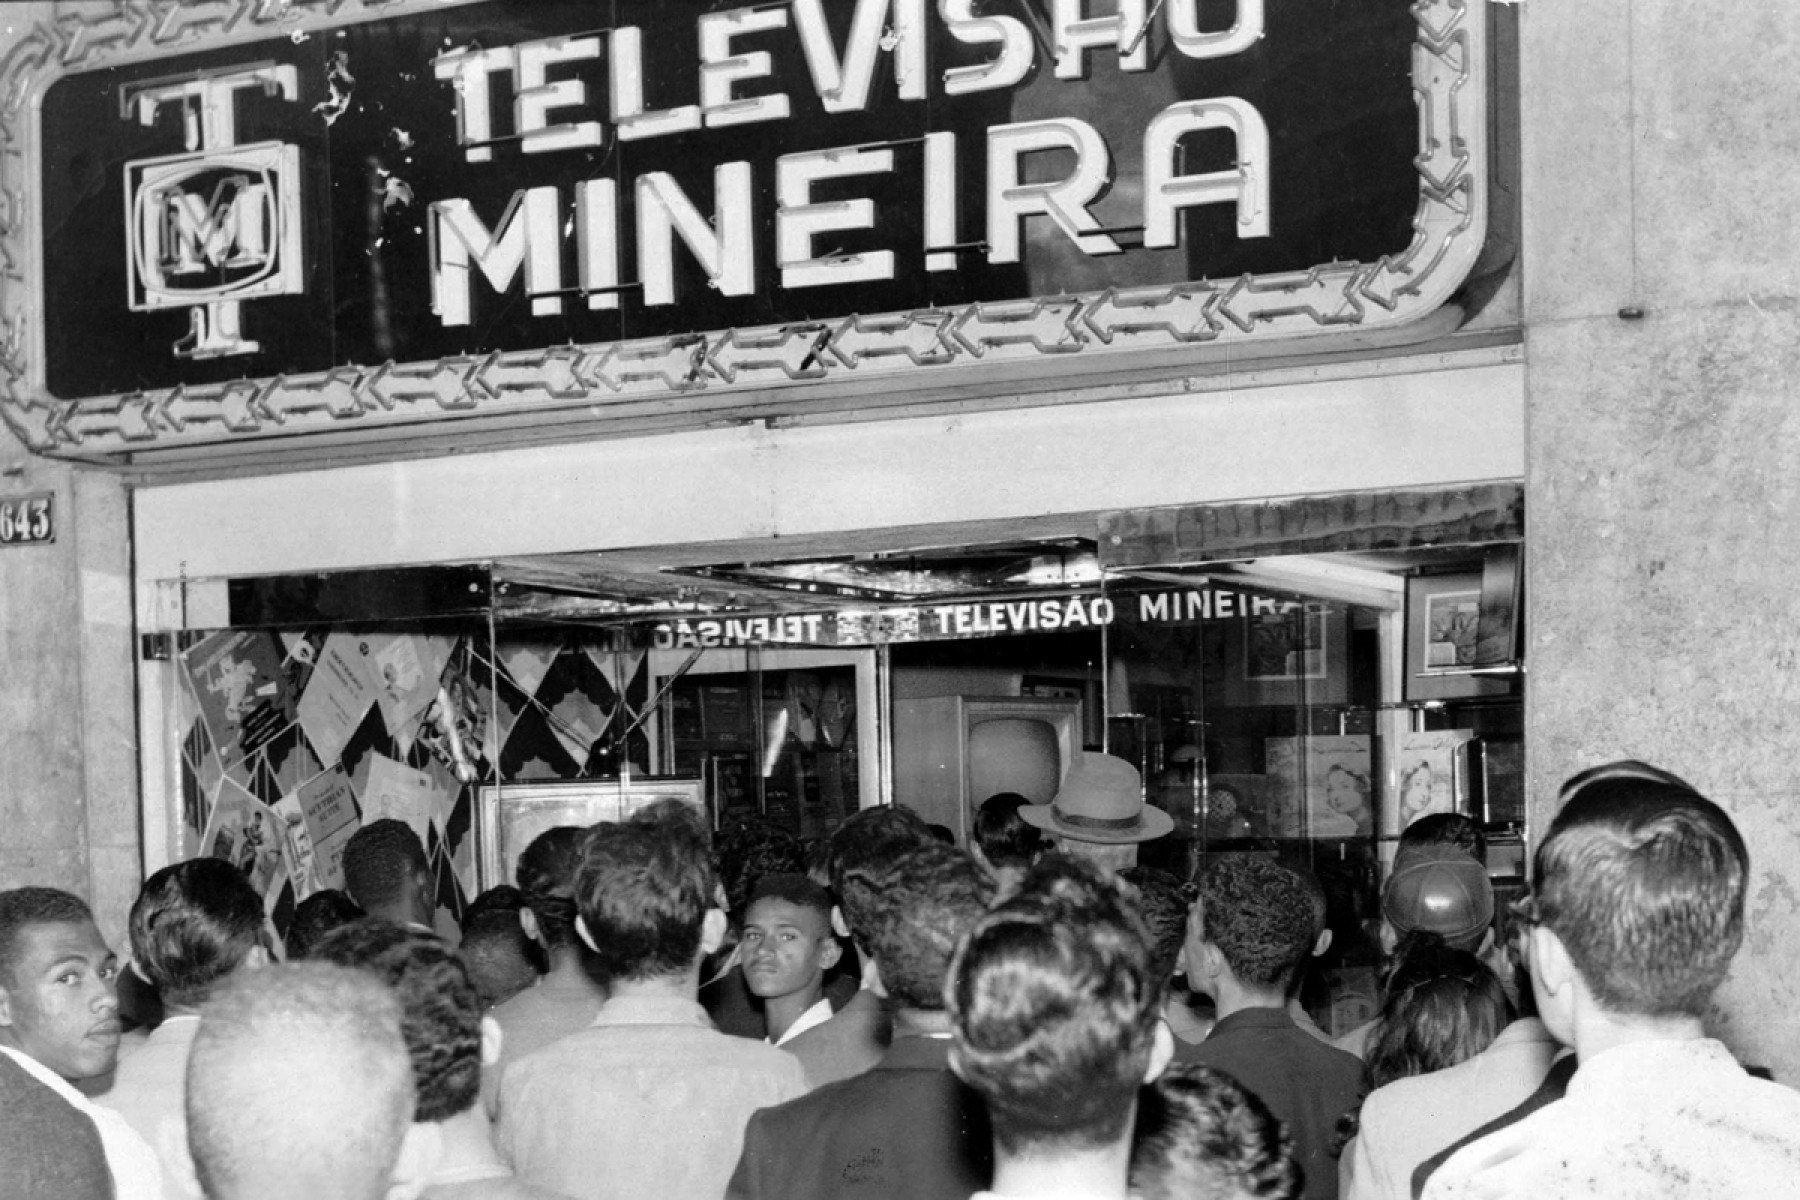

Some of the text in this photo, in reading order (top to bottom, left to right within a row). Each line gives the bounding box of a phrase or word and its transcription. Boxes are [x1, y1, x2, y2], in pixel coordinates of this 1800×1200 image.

[427, 97, 1270, 326] MINEIRA
[0, 500, 49, 541] 643
[935, 594, 1114, 634] TELEVISÃO
